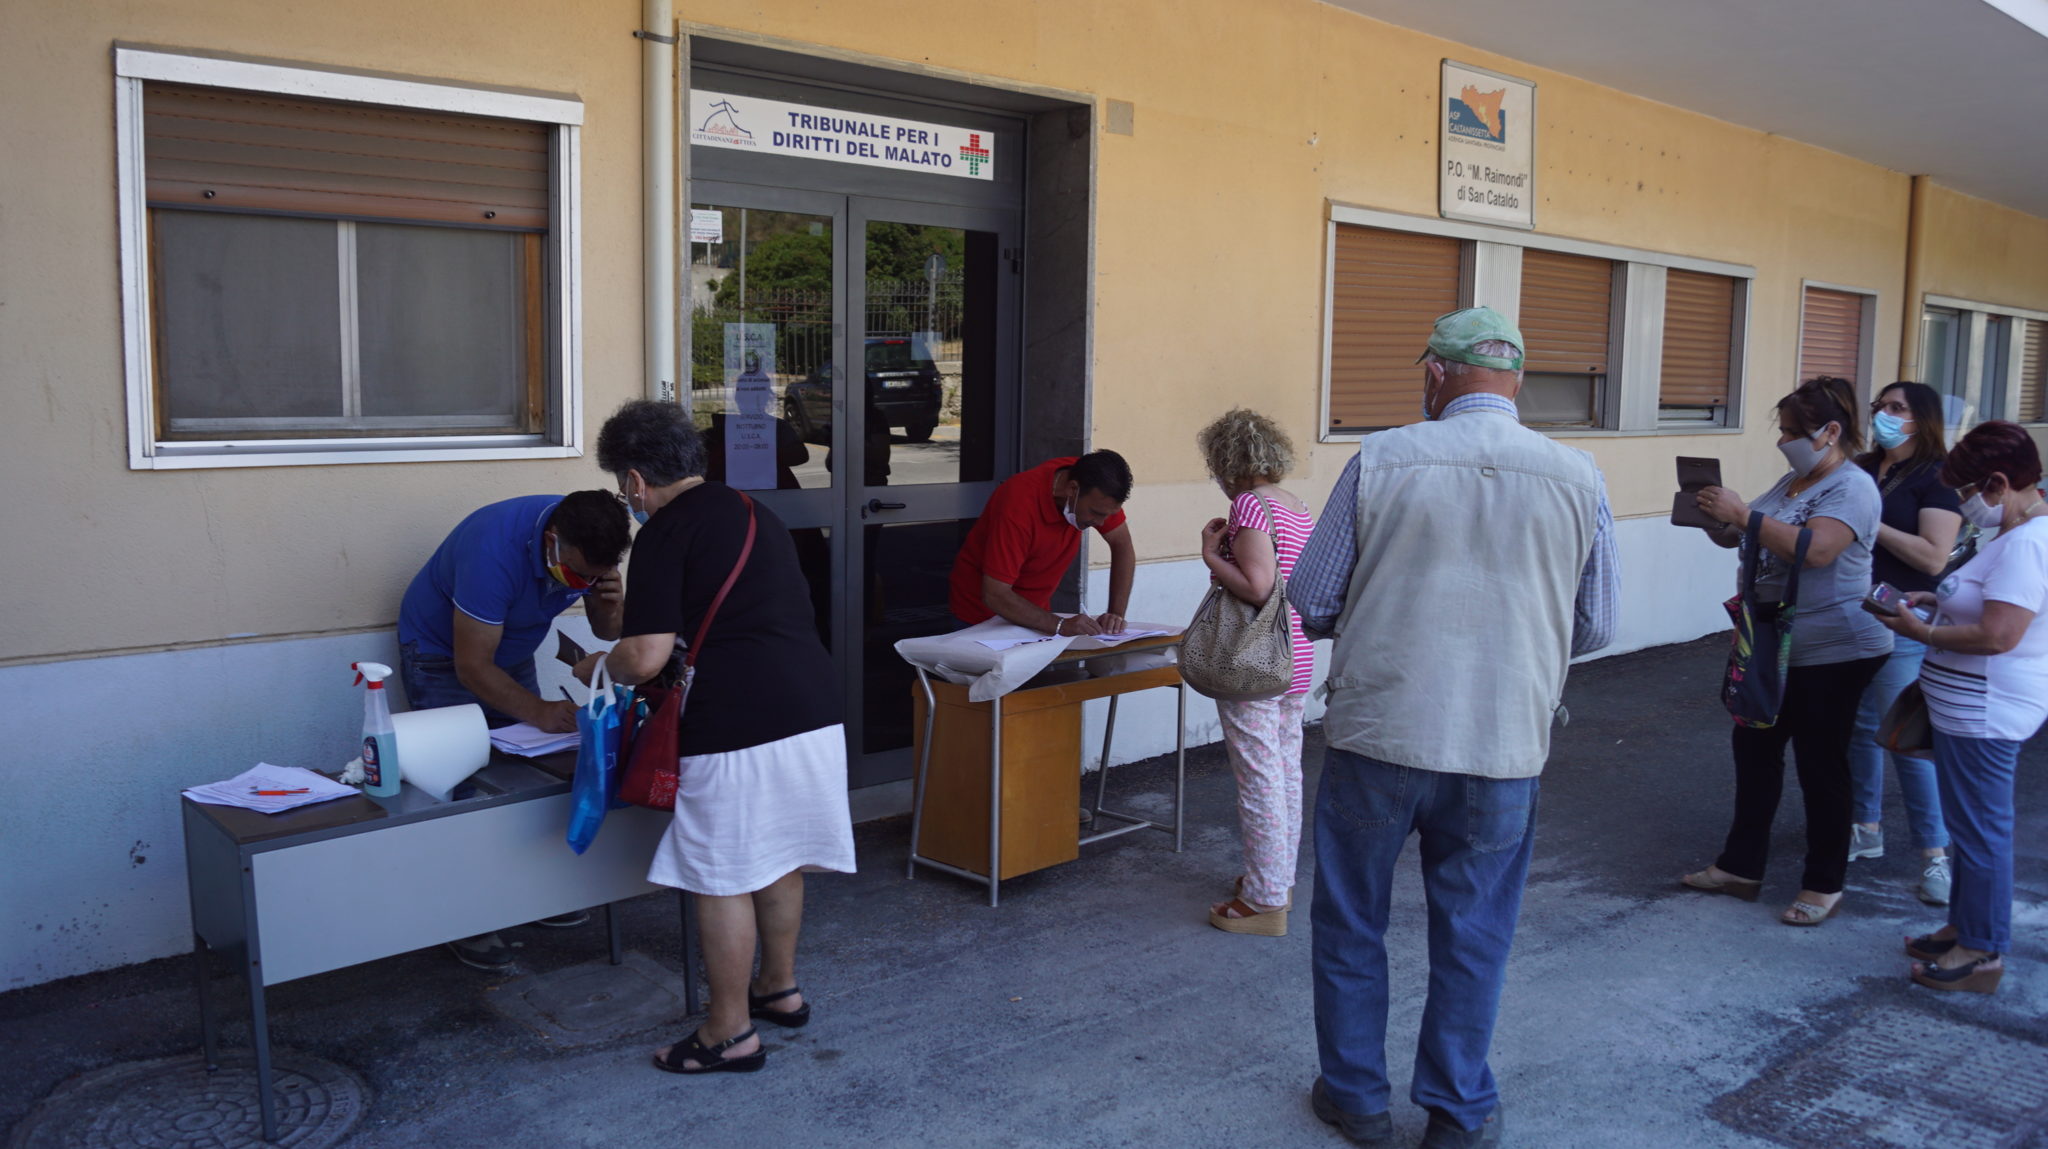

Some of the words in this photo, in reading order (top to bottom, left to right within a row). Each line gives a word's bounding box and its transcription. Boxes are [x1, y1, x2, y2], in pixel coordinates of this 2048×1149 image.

[788, 111, 891, 141] TRIBUNALE
[896, 126, 931, 146] PER
[934, 131, 939, 147] I
[1448, 122, 1491, 138] CALTANISSETTA
[772, 131, 840, 155] DIRITTI
[846, 140, 880, 159] DEL
[884, 145, 952, 168] MALATO
[1447, 160, 1465, 178] P.O.
[1457, 185, 1466, 201] di
[1468, 187, 1484, 204] San
[1486, 189, 1519, 209] Cataldo
